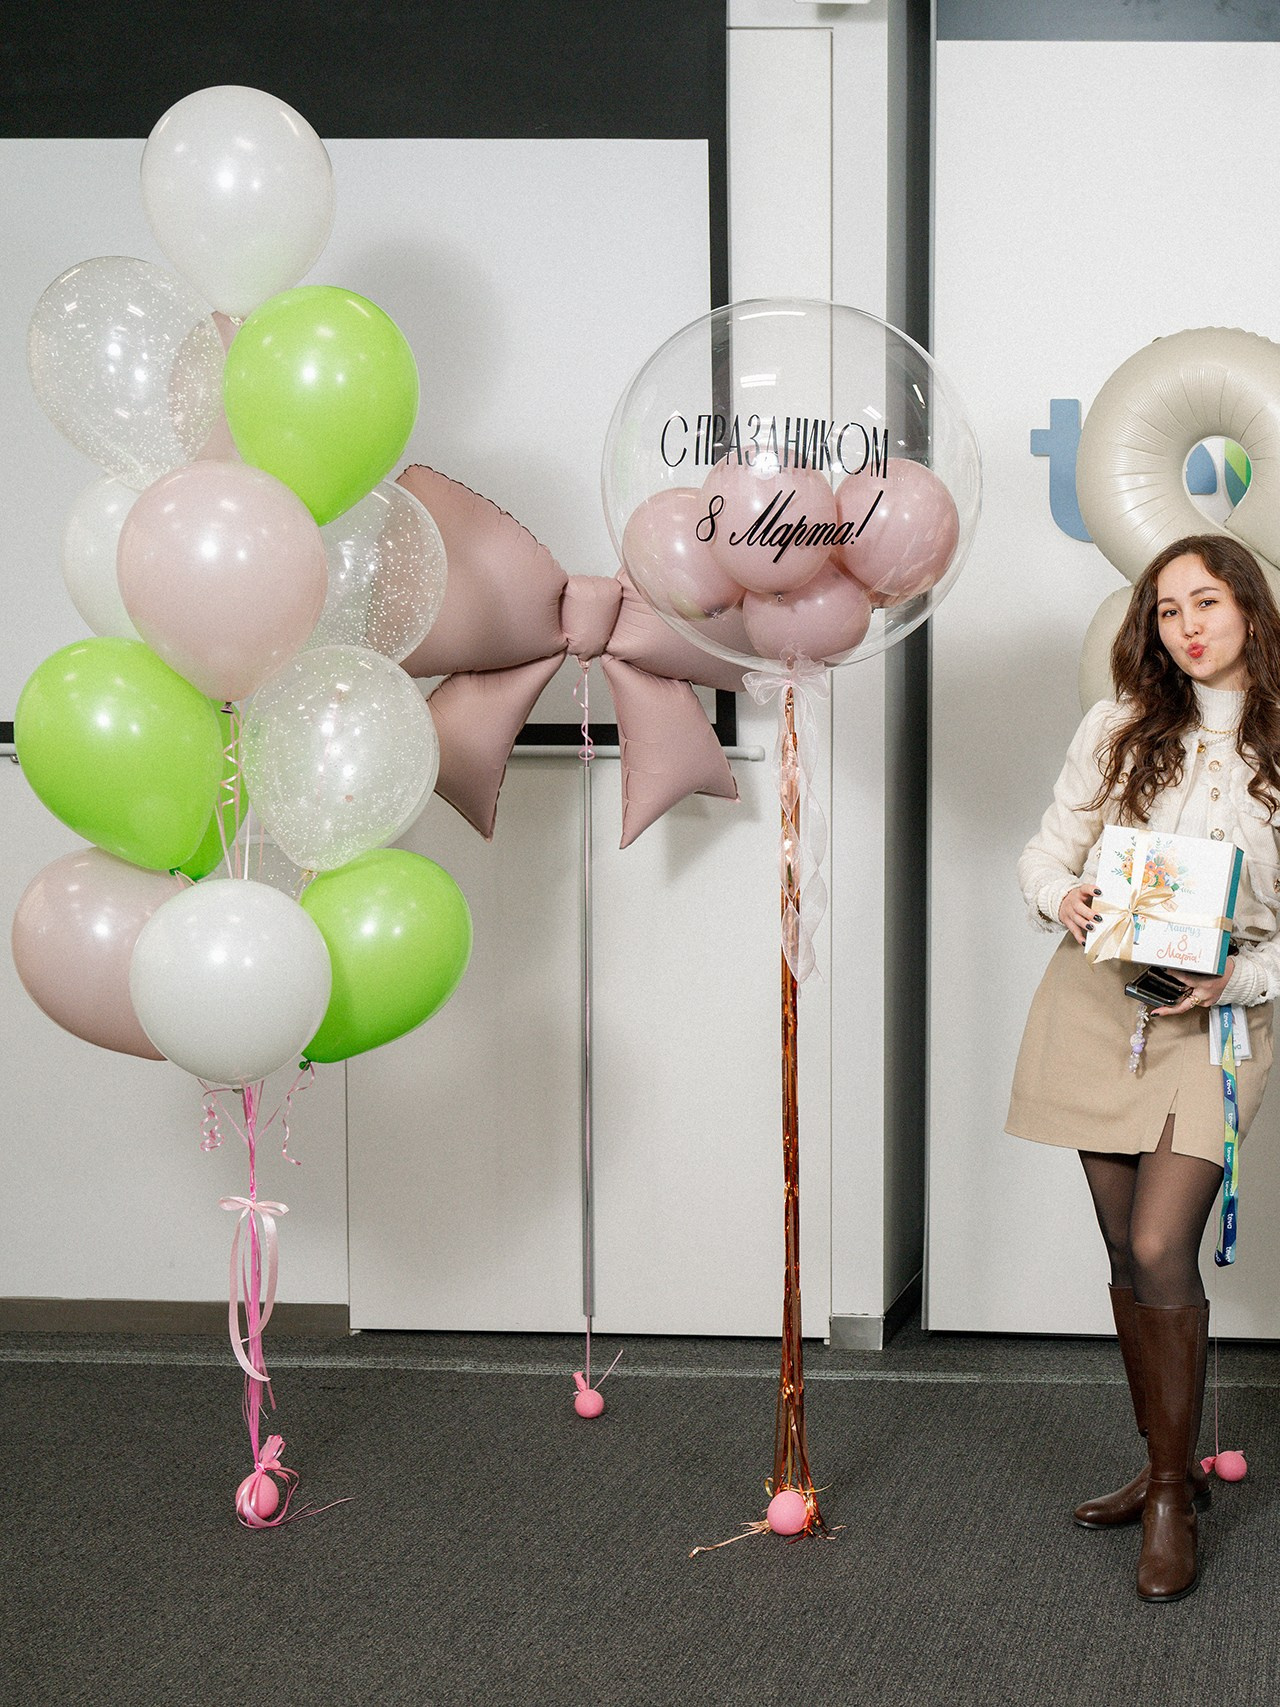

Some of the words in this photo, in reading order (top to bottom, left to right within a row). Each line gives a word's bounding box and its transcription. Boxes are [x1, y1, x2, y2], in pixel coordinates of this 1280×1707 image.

[660, 415, 689, 468] С
[694, 414, 889, 479] ПРАЗДНИКОМ
[695, 494, 725, 542] 8
[729, 489, 884, 564] Марта!
[1155, 941, 1203, 965] Марта!
[1177, 933, 1189, 952] 8
[1226, 1213, 1234, 1230] teva
